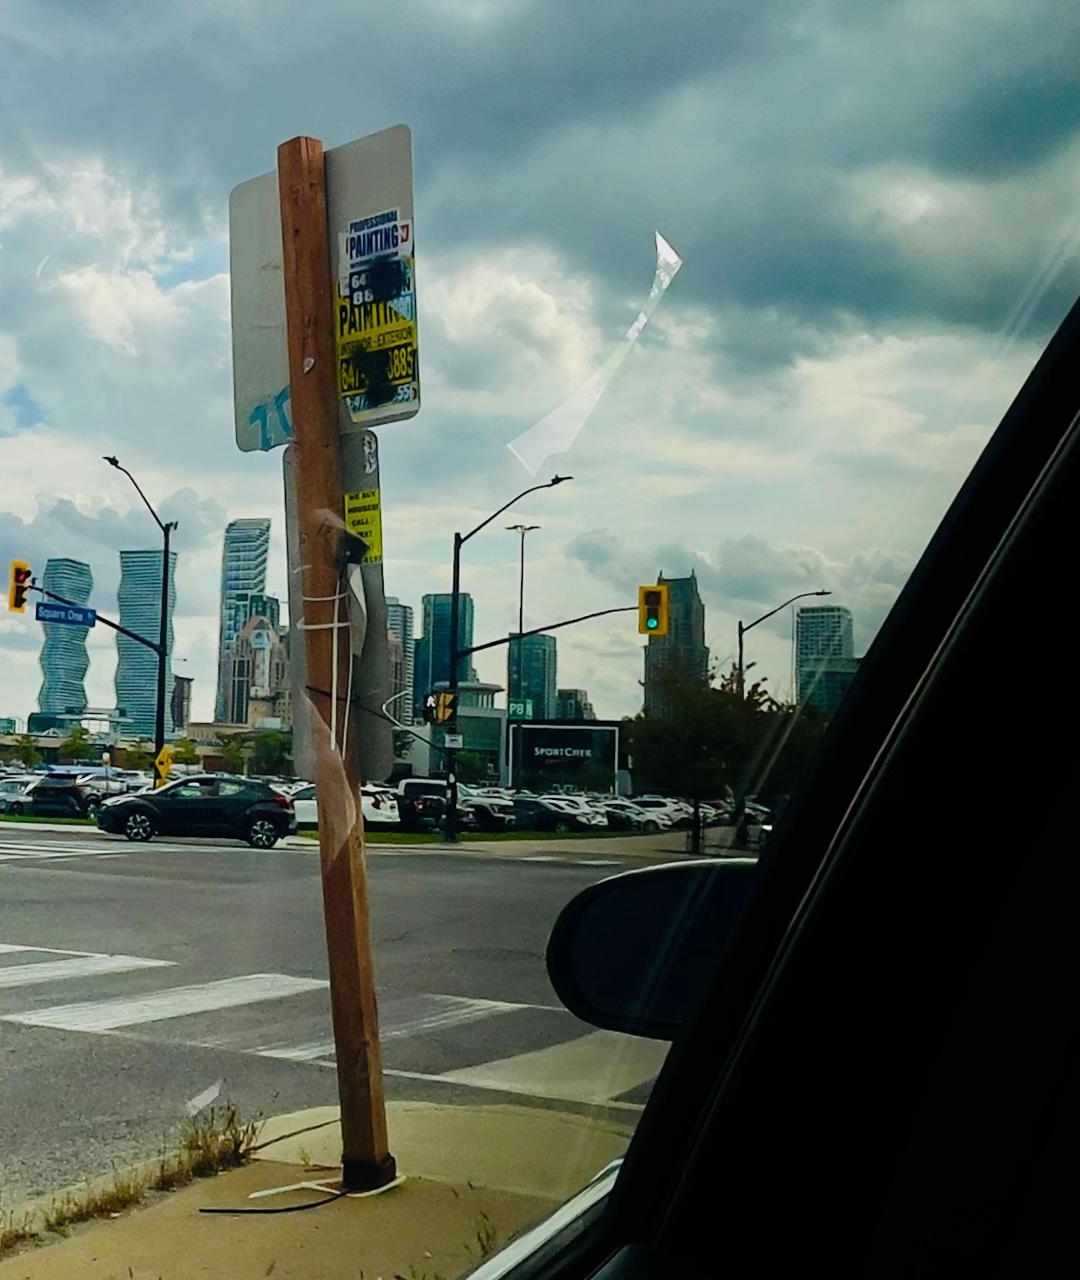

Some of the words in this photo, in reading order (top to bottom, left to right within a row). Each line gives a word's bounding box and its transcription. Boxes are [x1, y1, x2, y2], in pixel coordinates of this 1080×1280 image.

[350, 224, 399, 261] PAINTING
[339, 303, 408, 337] PAINTIN
[39, 606, 65, 619] Square
[68, 610, 83, 620] One
[510, 703, 524, 715] P8
